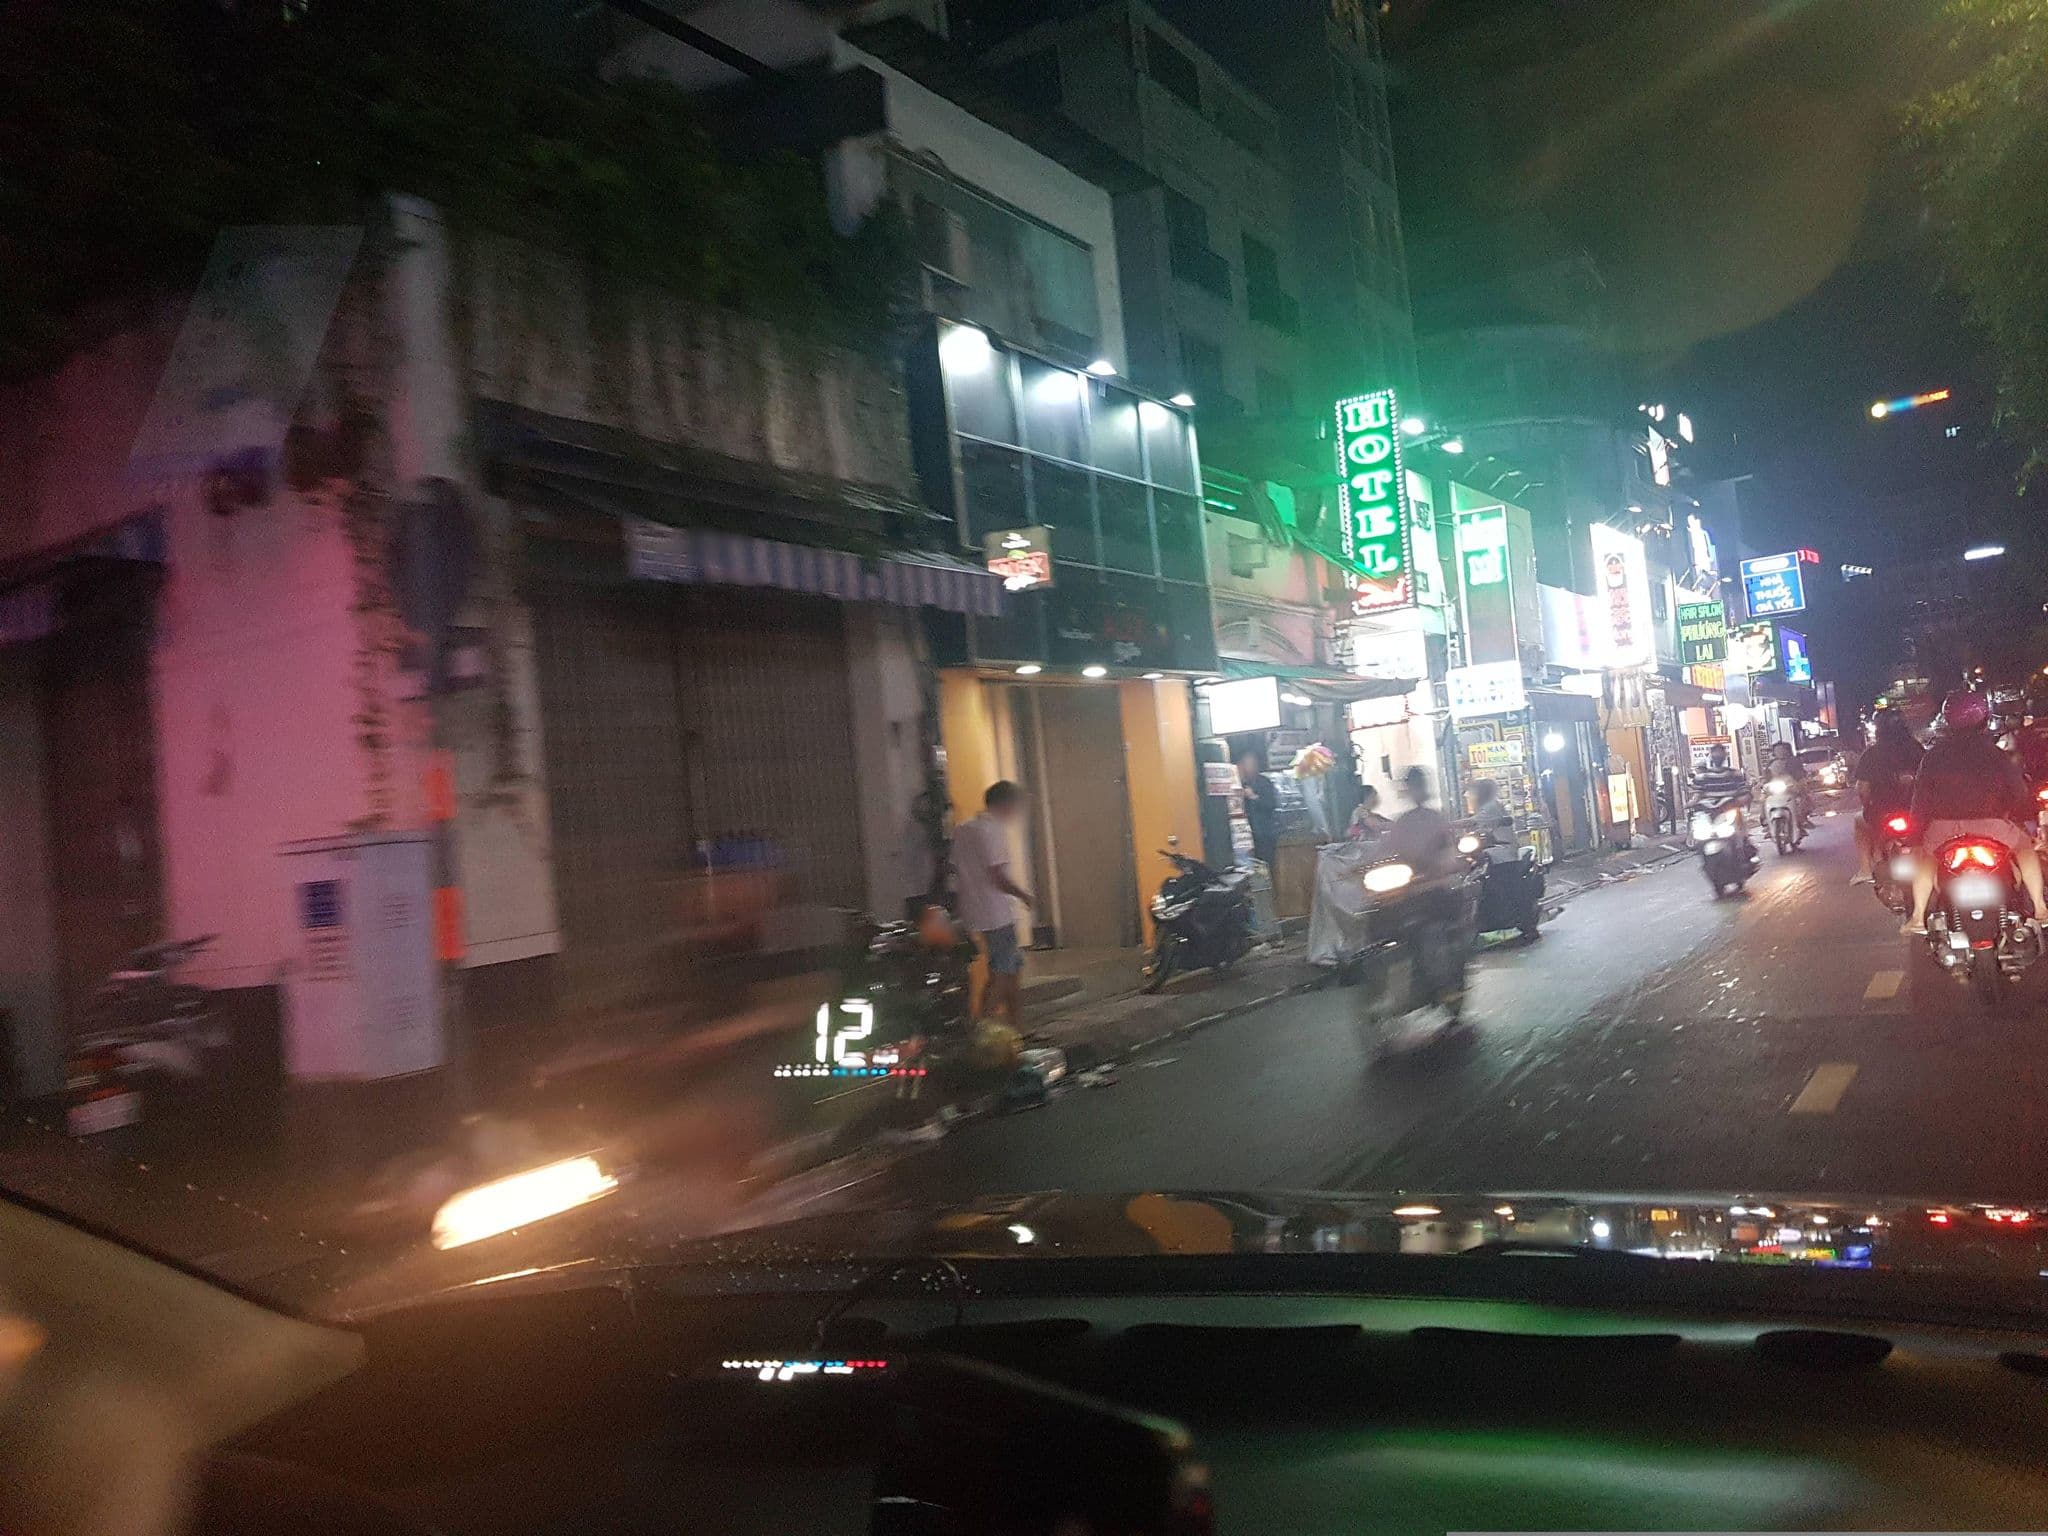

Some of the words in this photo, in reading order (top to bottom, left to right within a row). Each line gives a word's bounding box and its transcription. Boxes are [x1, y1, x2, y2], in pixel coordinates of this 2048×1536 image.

[1343, 398, 1399, 573] HOTEL
[1681, 606, 1697, 620] HAIR
[1698, 603, 1722, 618] SALON
[1695, 643, 1714, 661] LAI
[815, 998, 873, 1067] 12
